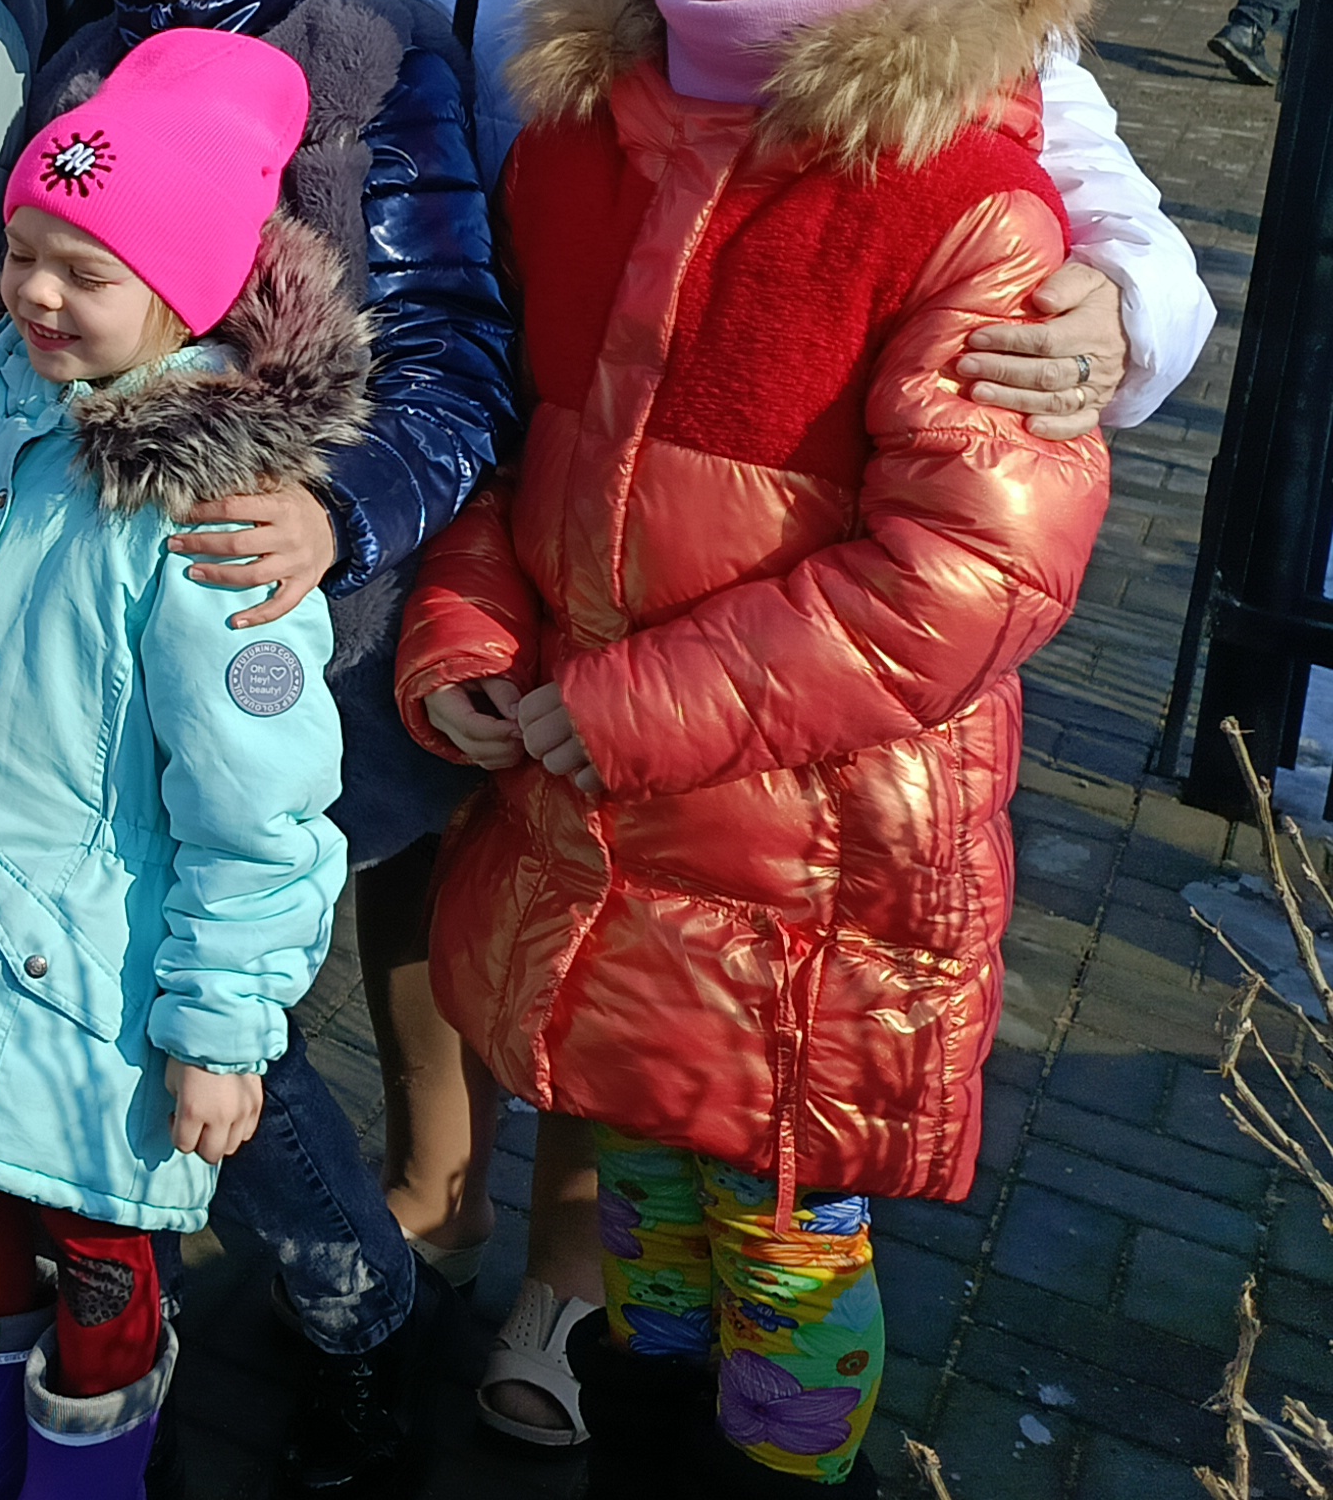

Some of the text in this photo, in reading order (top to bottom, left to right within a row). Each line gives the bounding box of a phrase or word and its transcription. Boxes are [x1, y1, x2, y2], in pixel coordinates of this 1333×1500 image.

[236, 645, 297, 670] FUTURINO COOL
[250, 664, 266, 674] Oh!
[250, 675, 270, 685] Hey!
[250, 686, 282, 697] beauty!
[233, 684, 300, 712] KEEP COLOURFUL
